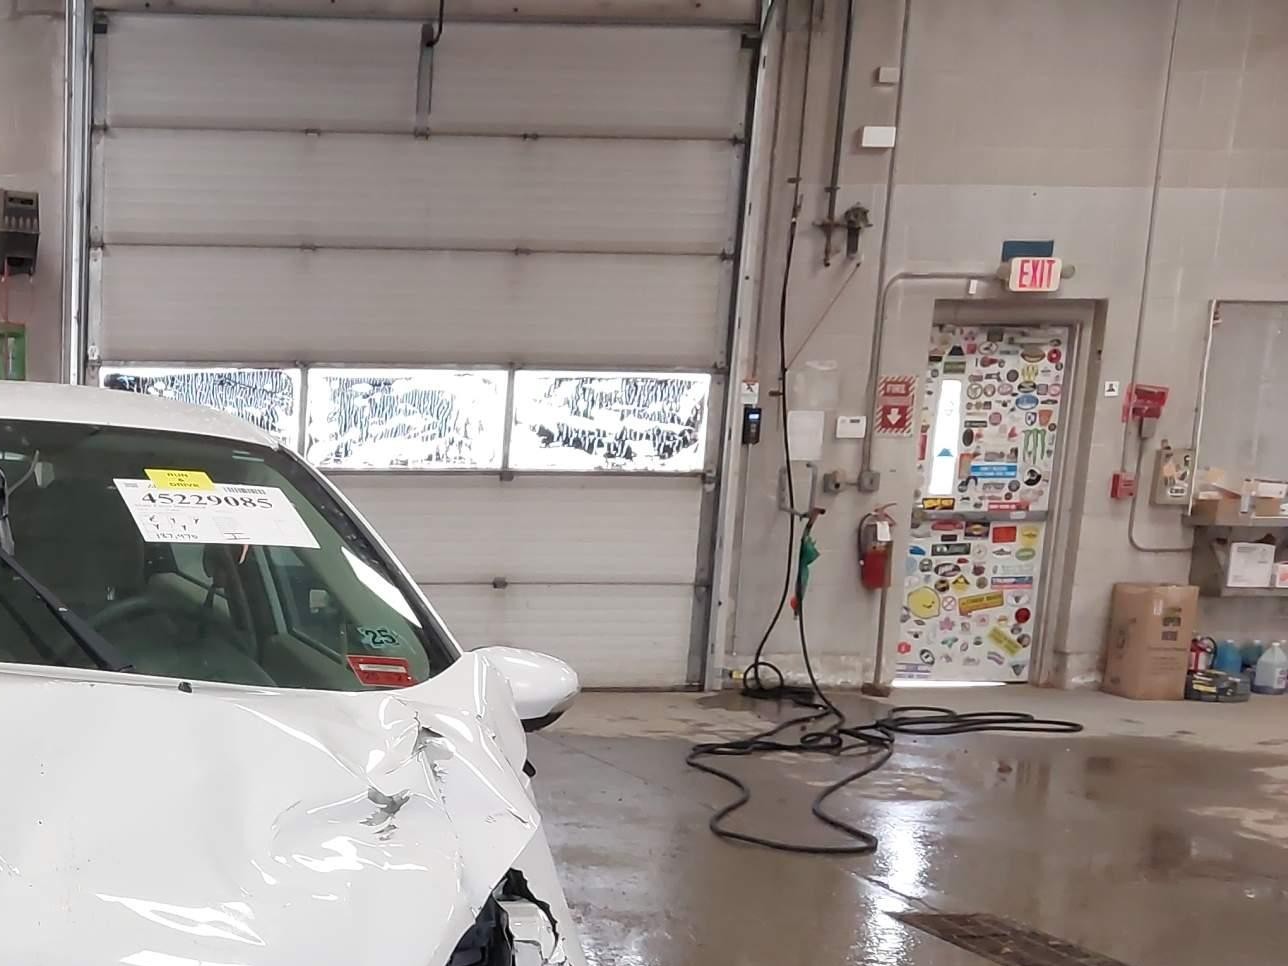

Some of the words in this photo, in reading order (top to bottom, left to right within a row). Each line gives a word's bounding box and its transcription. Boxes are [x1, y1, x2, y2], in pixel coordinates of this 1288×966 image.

[1018, 259, 1056, 289] EXIT
[142, 492, 273, 509] 45229085
[365, 629, 397, 645] 25
